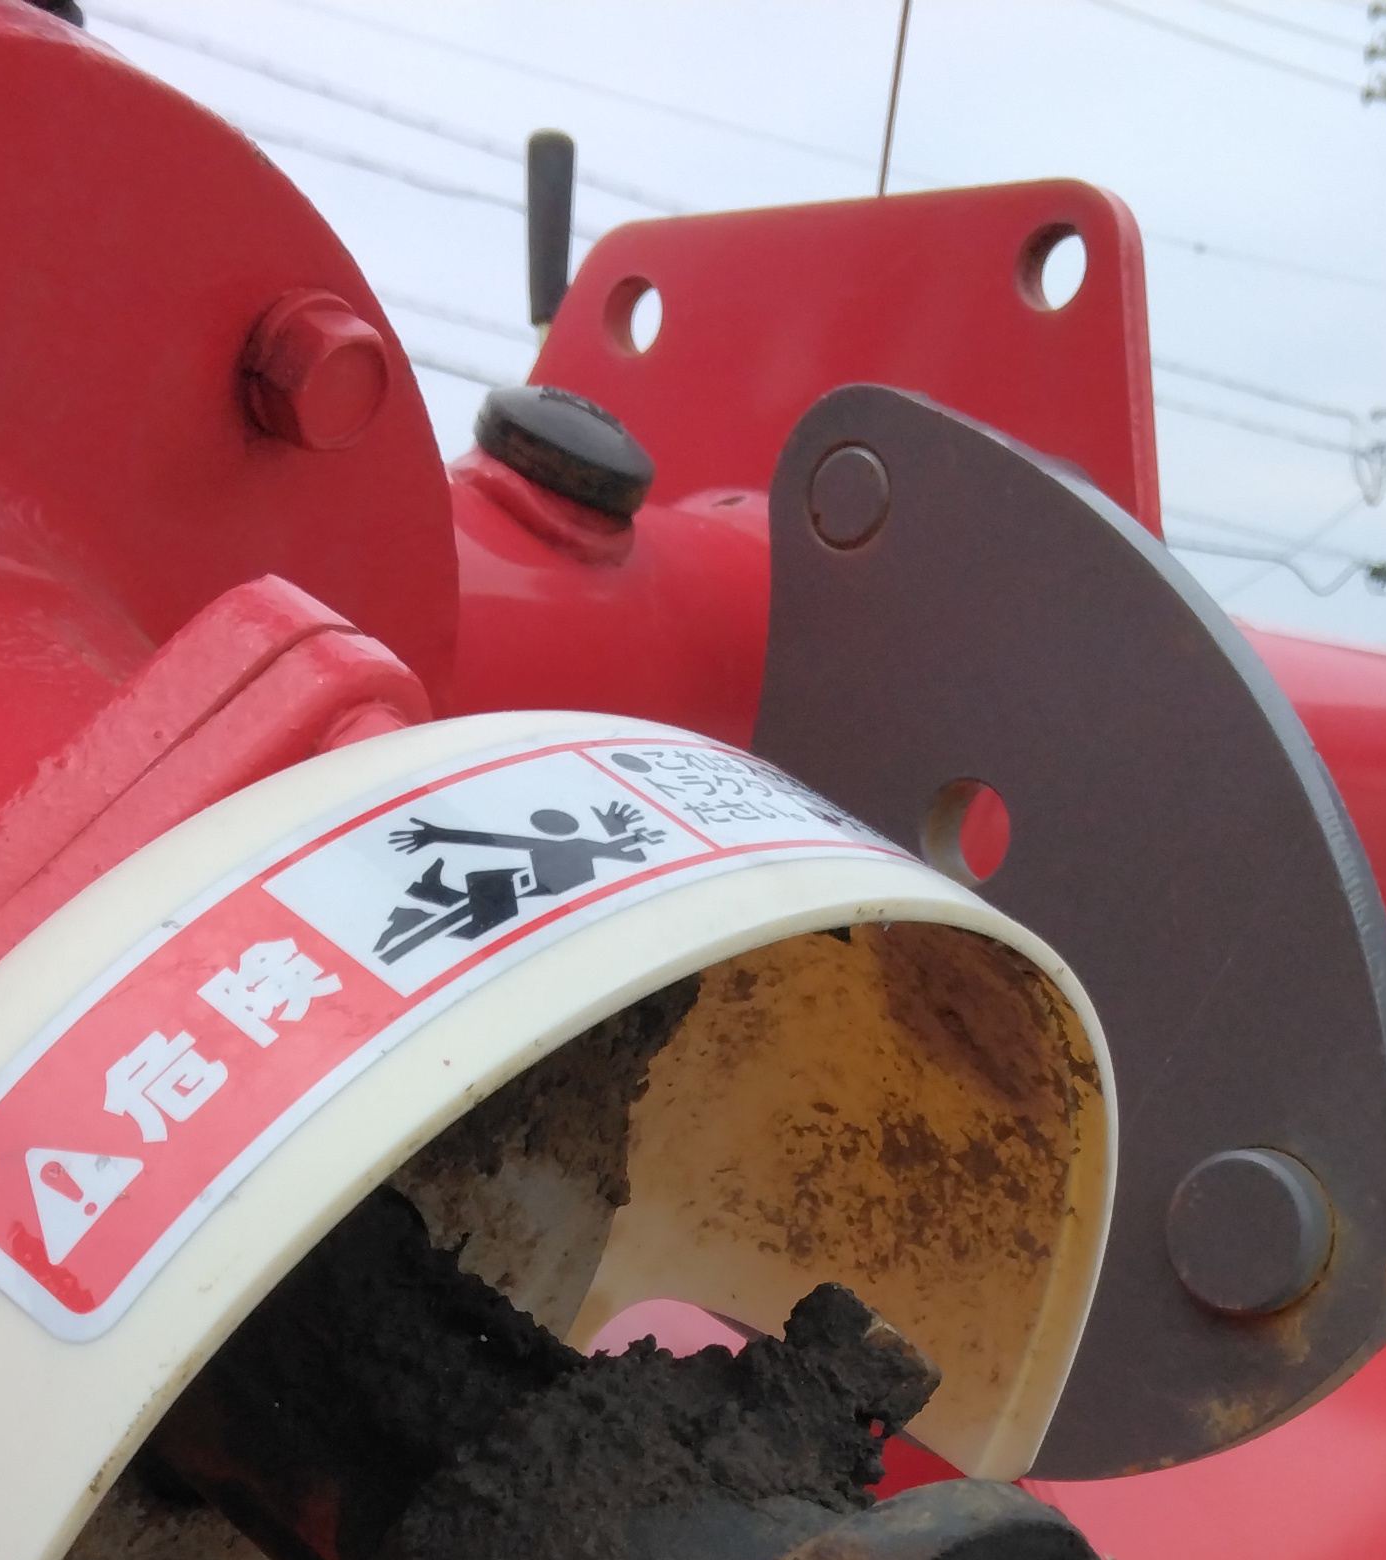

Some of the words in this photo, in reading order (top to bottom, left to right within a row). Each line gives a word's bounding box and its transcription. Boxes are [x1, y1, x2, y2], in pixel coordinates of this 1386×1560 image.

[683, 800, 806, 824] ださい。
[103, 937, 343, 1142] 危険
